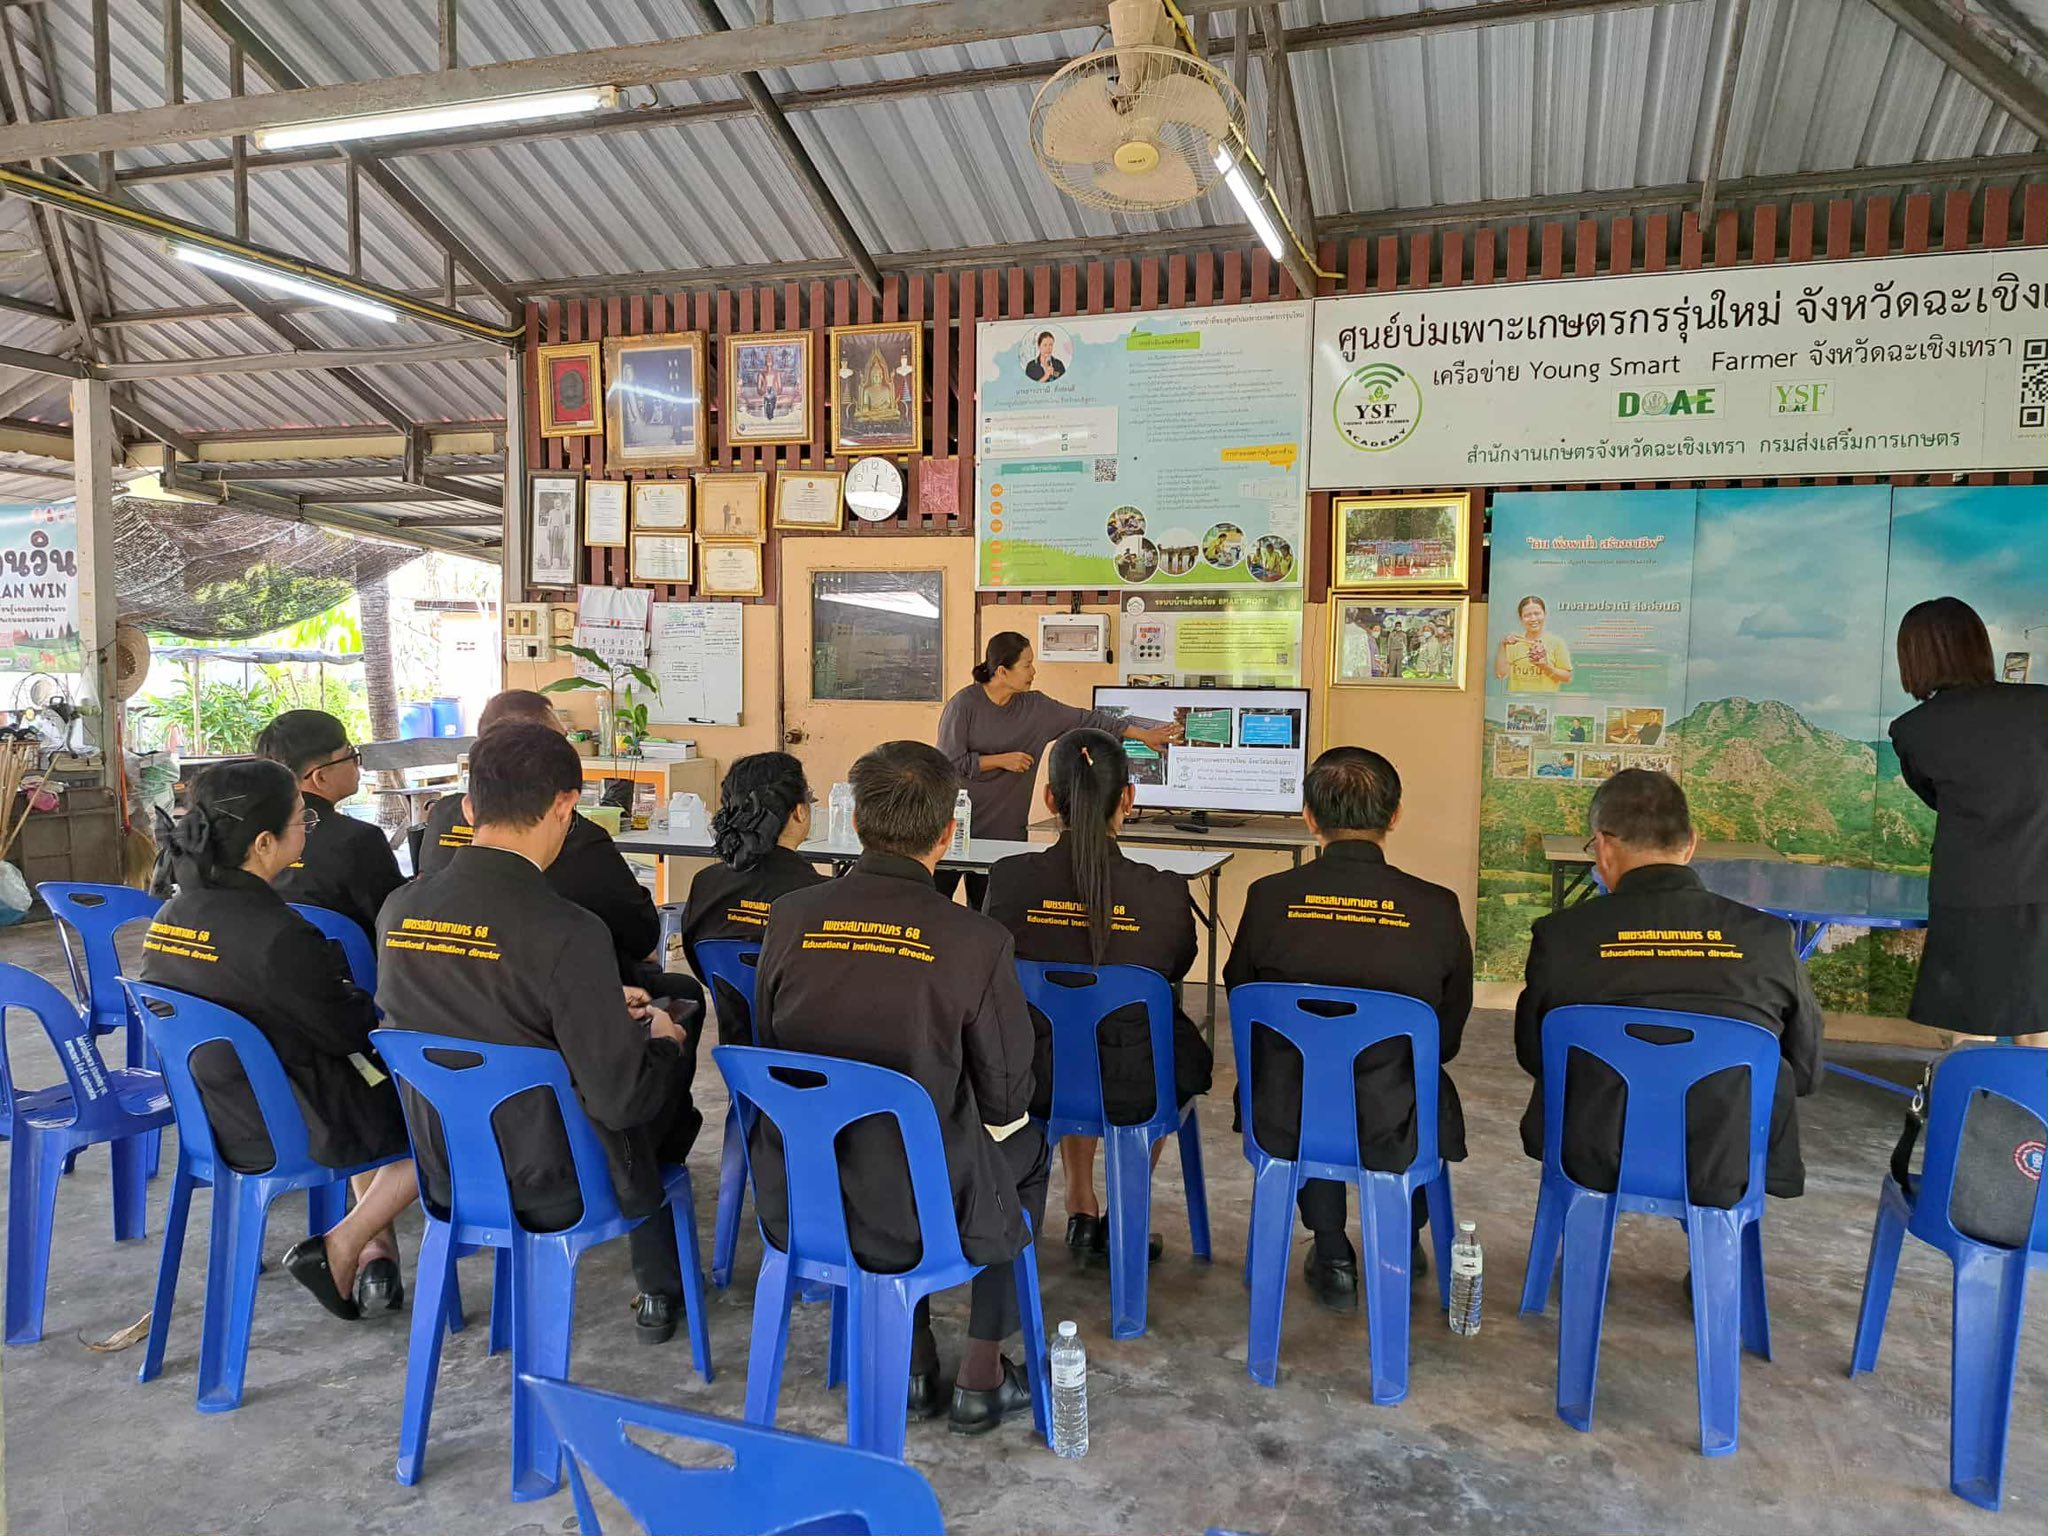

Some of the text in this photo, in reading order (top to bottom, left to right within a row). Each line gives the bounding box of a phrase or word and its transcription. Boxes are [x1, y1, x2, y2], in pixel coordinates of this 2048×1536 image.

[1338, 288, 1781, 362] ศูนย์บ่มเพาะเกษตรกรรุ่นใหม่
[1434, 333, 2013, 386] เครือข่าย Young Smart Farmer จังหวัดฉะเชิงเทรา
[1775, 383, 1828, 412] YSF
[1354, 403, 1398, 419] YSF
[1345, 427, 1406, 447] ACADEMY
[1467, 430, 1961, 465] สำนักงานเกษตรจังหวัดฉะเชิงเทรา กรมส่งเสริมการเกษตร
[0, 530, 78, 577] นวิน
[0, 582, 67, 599] AN WIN
[1113, 904, 1126, 915] 68
[1381, 899, 1395, 911] 68
[474, 925, 489, 938] 68
[904, 926, 921, 940] 68
[1706, 930, 1723, 942] 68
